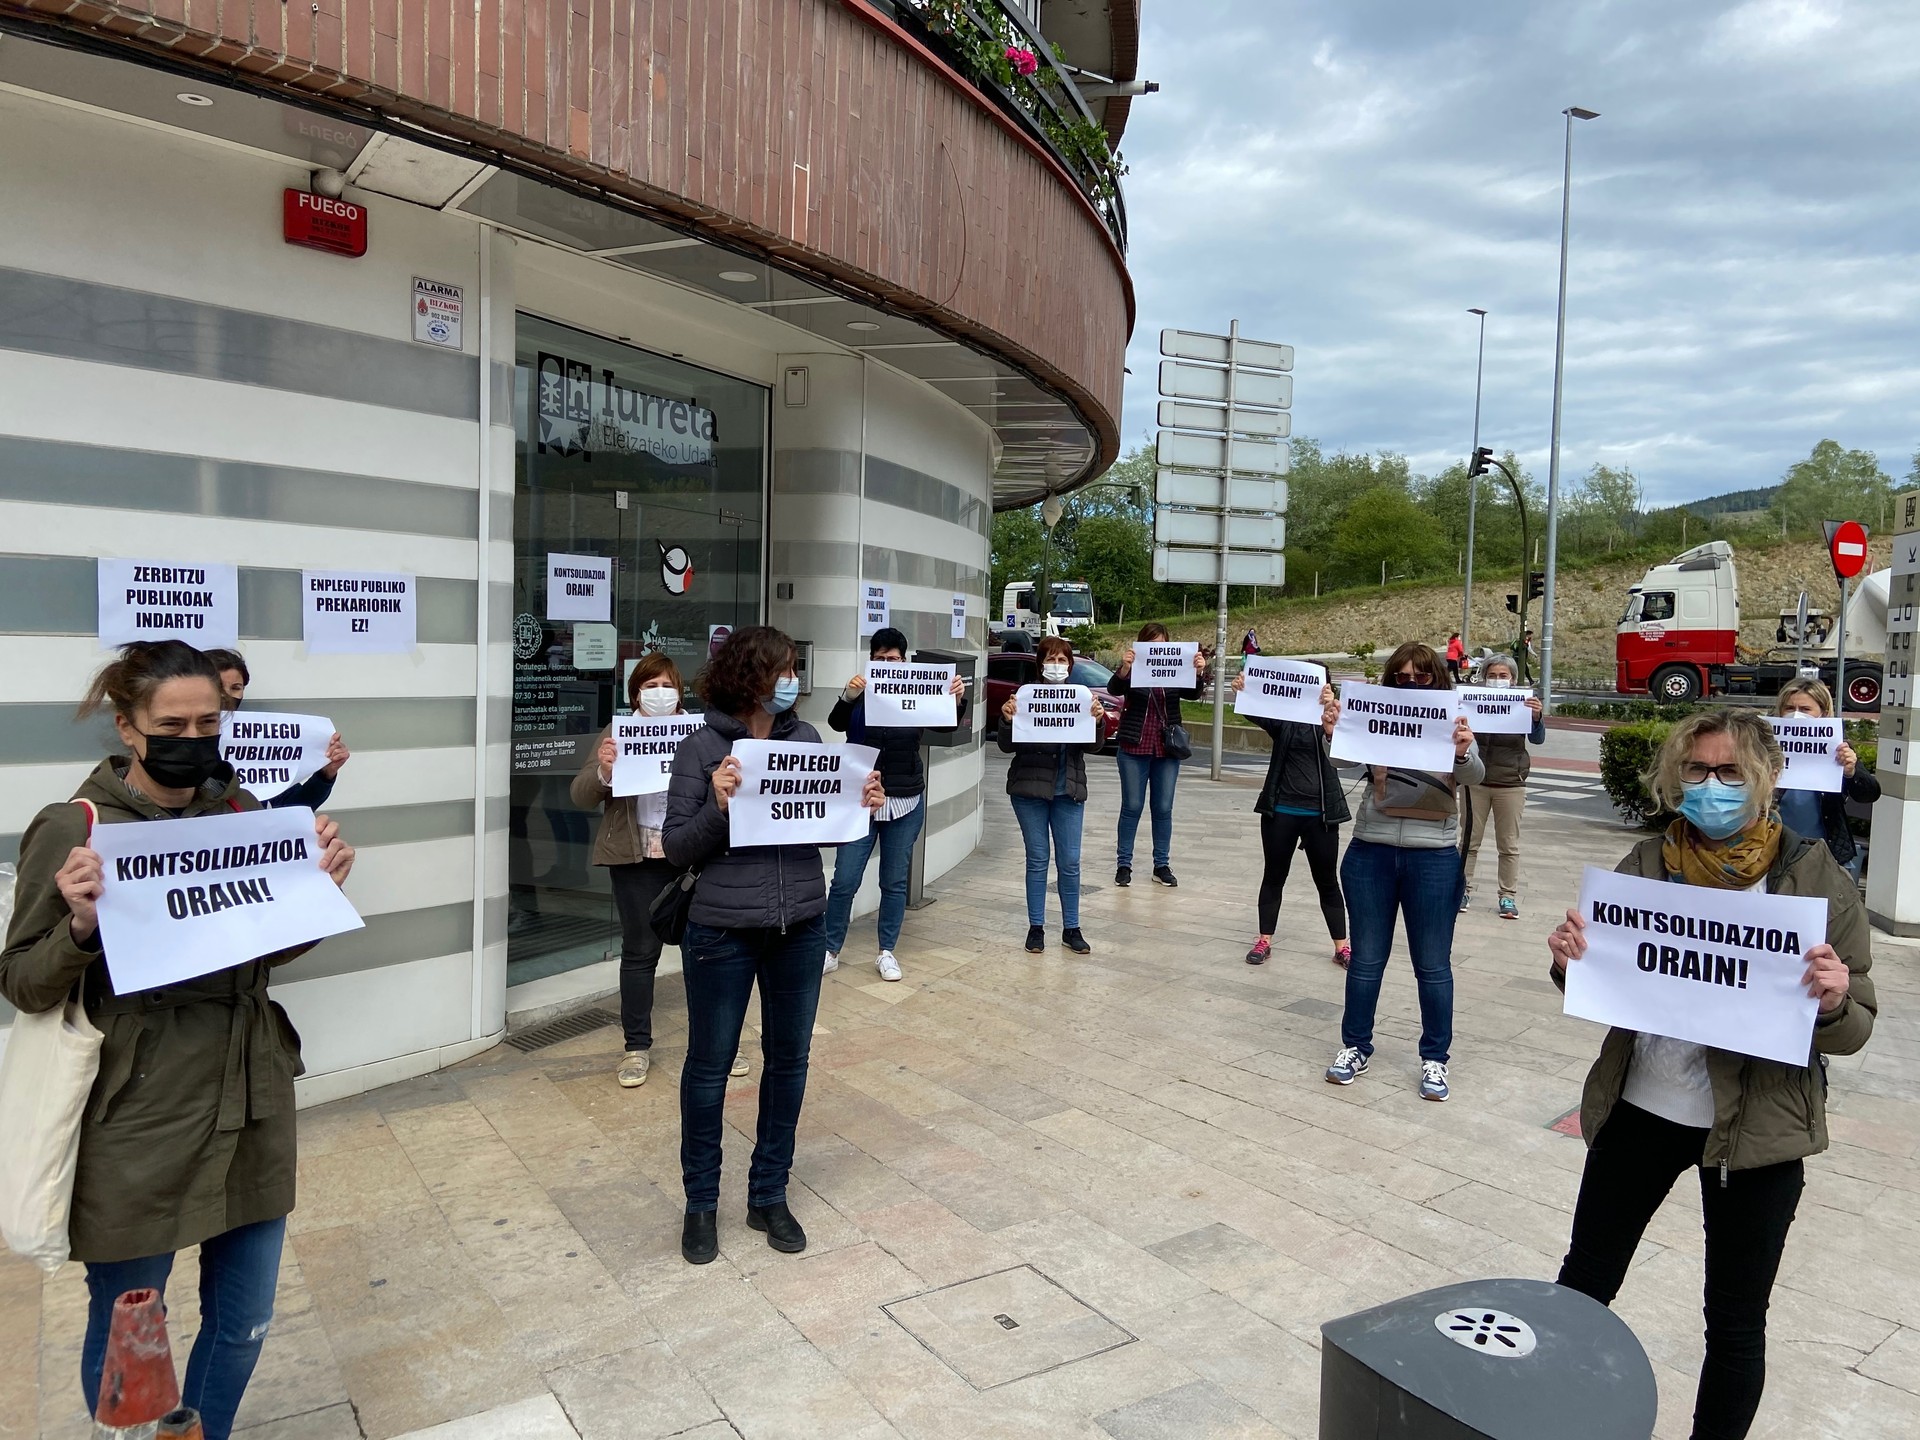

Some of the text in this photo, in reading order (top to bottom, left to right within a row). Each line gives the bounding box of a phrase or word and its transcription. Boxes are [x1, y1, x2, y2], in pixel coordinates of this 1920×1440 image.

[299, 193, 358, 220] FUEGO
[417, 281, 460, 298] ALARMA
[602, 369, 719, 442] Iurreta
[603, 425, 718, 468] Eleizateko Udala
[133, 566, 205, 585] ZERBITZU
[554, 567, 605, 580] KONTSOLIDAZIOA
[310, 578, 406, 594] ENPLEGU PUBLIKO
[566, 583, 594, 597] ORAIN!
[126, 590, 213, 608] PUBLIKOAK
[316, 596, 402, 613] PREKARIORIK
[136, 611, 204, 630] INDARTU
[351, 618, 369, 633] EZ!
[652, 636, 666, 646] HAZ
[1149, 647, 1181, 656] ENPLEGU
[515, 663, 547, 672] Ordutegia
[1146, 658, 1183, 667] PUBLIKOA
[515, 674, 552, 682] astelehenetik
[870, 668, 909, 680] ENPLEGU
[910, 669, 948, 681] PUBLIKO
[1151, 669, 1176, 678] SORTU
[1248, 667, 1320, 686] KONTSOLIDAZIOA
[874, 683, 943, 696] PREKARIORIK
[1032, 688, 1076, 700] ZERBITZU
[1262, 682, 1301, 699] ORAIN!
[902, 699, 916, 710] EZ!
[1463, 693, 1526, 702] KONTSOLIDAZIOA
[514, 705, 547, 714] larunbatak
[559, 704, 585, 713] igandeak
[1028, 703, 1081, 714] PUBLIKOAK
[1347, 698, 1447, 721] KONTSOLIDAZIOA
[1477, 704, 1511, 715] ORAIN!
[541, 713, 567, 721] domingos
[1033, 717, 1075, 728] INDARTU
[233, 723, 301, 740] ENPLEGU
[538, 723, 555, 731] 21:00
[620, 722, 706, 738] ENPLEGU PUBL
[1368, 719, 1423, 739] ORAIN!
[1784, 726, 1834, 738] PUBLIKO
[224, 745, 303, 761] PUBLIKOA
[515, 743, 532, 751] deitu
[532, 742, 545, 750] inor
[554, 740, 576, 749] badago
[624, 741, 681, 755] PREKAR
[1780, 740, 1828, 755] RIORIK
[530, 750, 542, 758] hay
[515, 759, 551, 769] 946 200 888
[661, 760, 672, 774] EZ
[767, 753, 841, 772] ENPLEGU
[236, 767, 290, 785] SORTU
[759, 779, 841, 795] PUBLIKOA
[770, 801, 826, 820] SORTU
[116, 838, 308, 881] KONTSOLIDAZIOA
[167, 877, 274, 920] ORAIN!
[1592, 900, 1801, 955] KONTSOLIDAZIOA
[1636, 941, 1749, 990] ORAIN!
